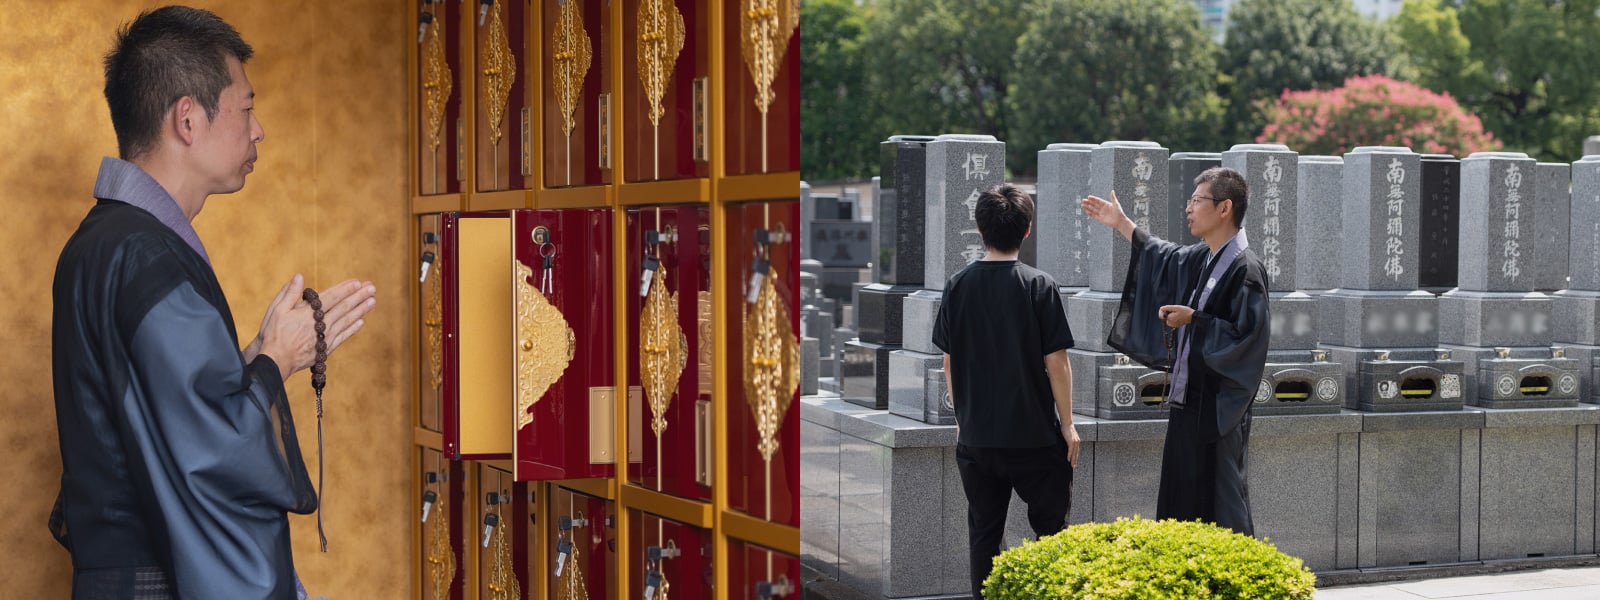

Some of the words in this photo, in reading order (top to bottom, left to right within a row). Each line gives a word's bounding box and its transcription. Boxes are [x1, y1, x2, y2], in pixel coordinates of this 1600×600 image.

[1384, 158, 1405, 282] 南無阿彌陀佛
[1502, 162, 1521, 283] 南無阿彌陀佛
